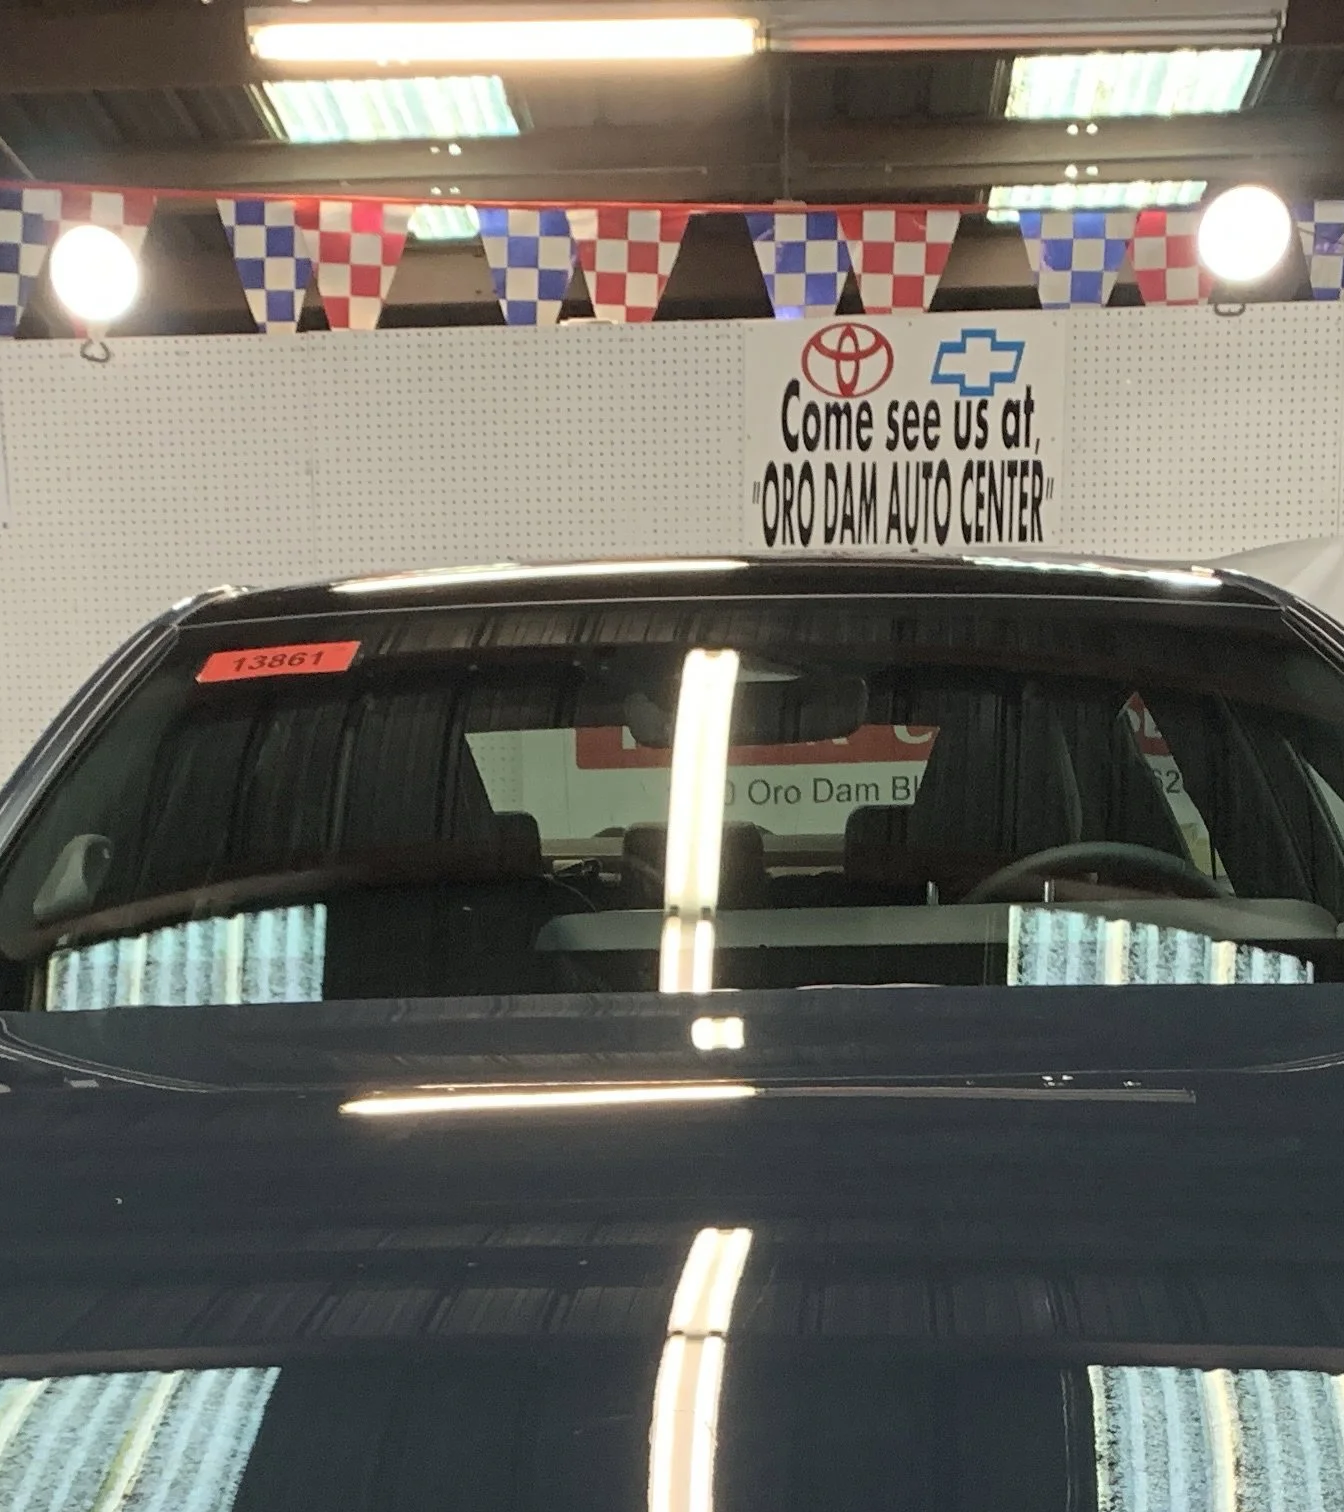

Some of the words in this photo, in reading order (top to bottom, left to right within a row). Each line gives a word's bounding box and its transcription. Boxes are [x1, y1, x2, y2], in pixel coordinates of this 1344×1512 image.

[781, 378, 873, 452] Come
[886, 400, 941, 452] see
[954, 399, 989, 450] us
[824, 460, 877, 545] DAM
[886, 458, 951, 546] AUTO
[232, 651, 325, 672] 13861
[748, 779, 802, 805] Oro
[813, 777, 880, 803] Dam
